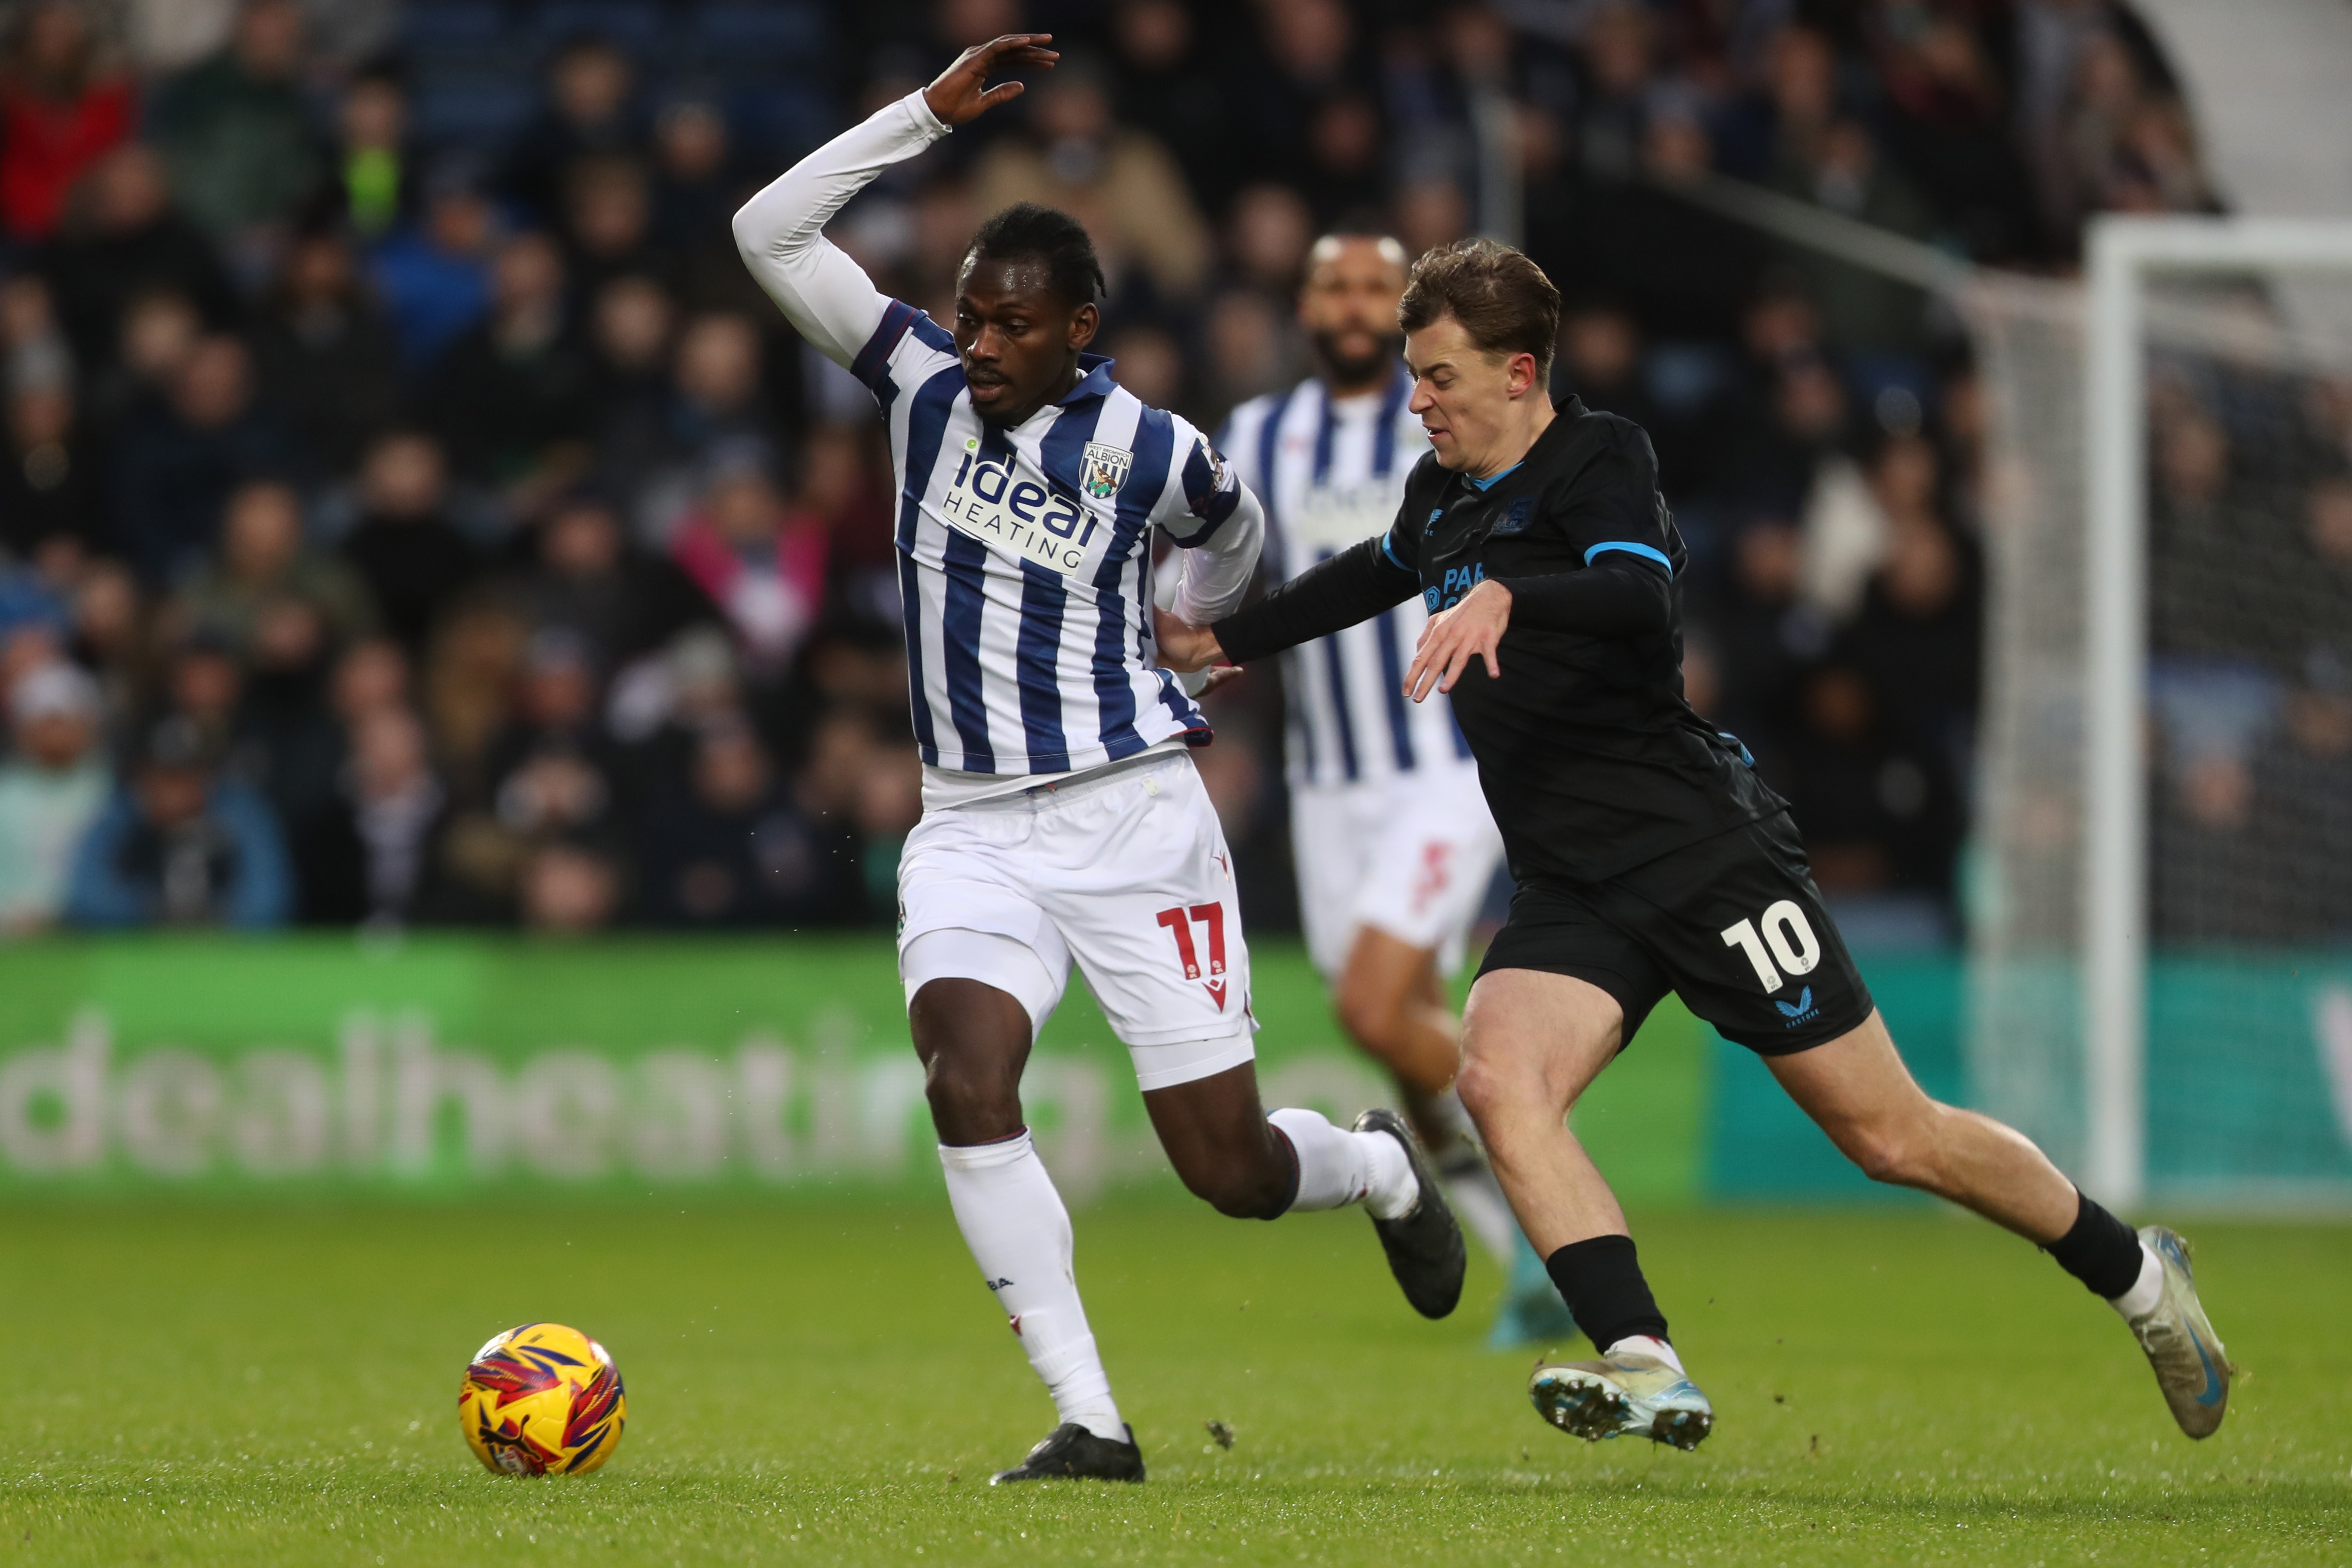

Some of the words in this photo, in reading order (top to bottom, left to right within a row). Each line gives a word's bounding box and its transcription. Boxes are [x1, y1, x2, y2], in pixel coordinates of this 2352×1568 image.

[1086, 449, 1128, 467] ALBION
[1103, 448, 1129, 458] BROMWICH
[943, 491, 1082, 568] HEATING
[953, 438, 1099, 547] ideal
[1156, 901, 1226, 980] 17
[1720, 899, 1821, 994] 10
[1786, 1008, 1820, 1028] CASTORE
